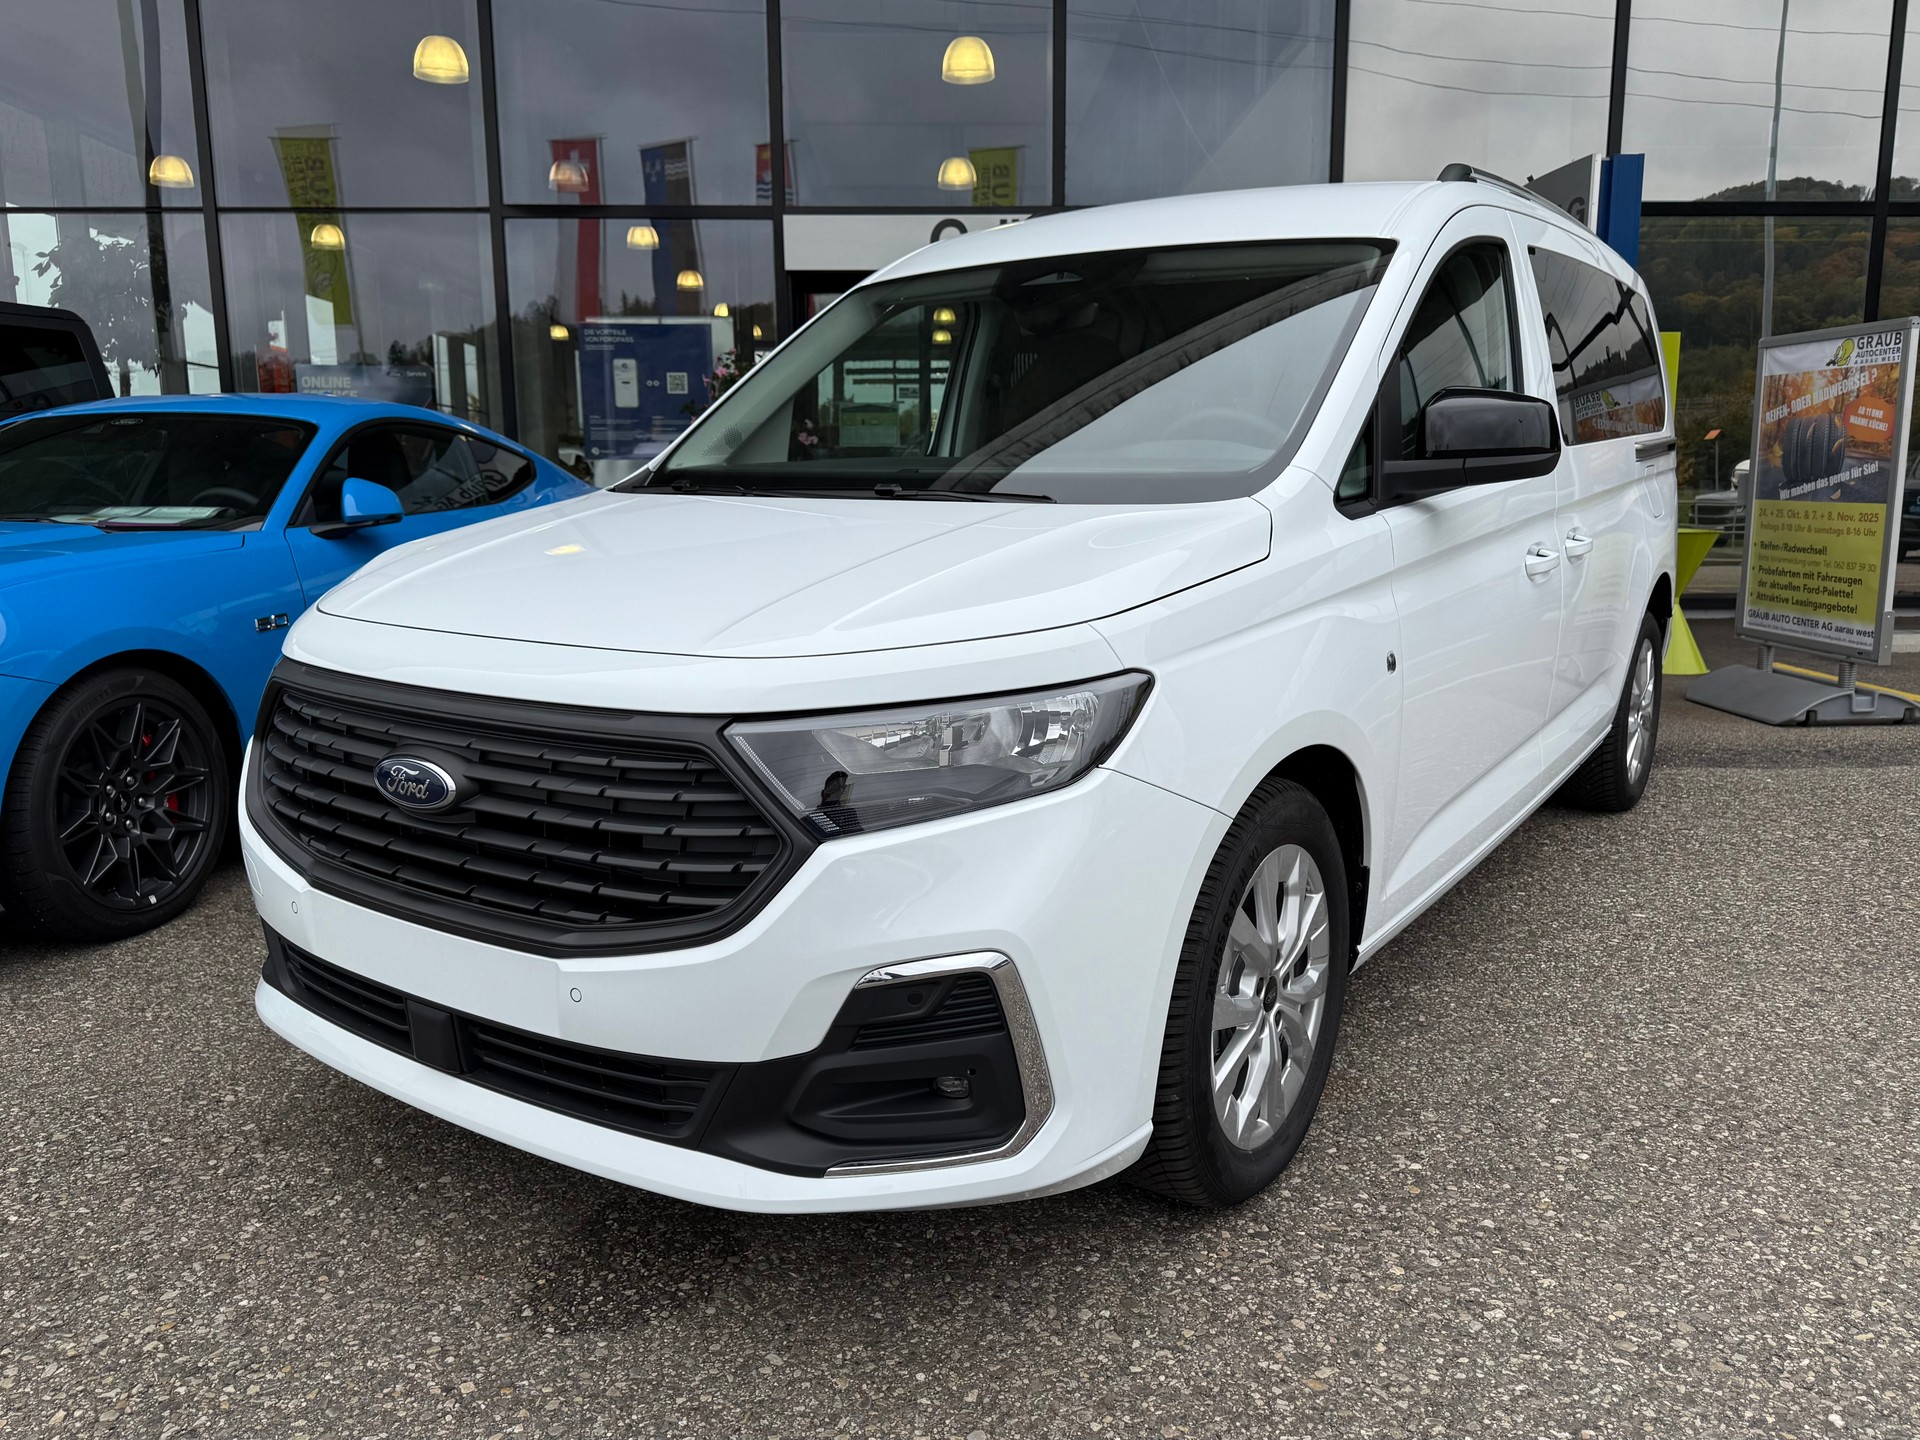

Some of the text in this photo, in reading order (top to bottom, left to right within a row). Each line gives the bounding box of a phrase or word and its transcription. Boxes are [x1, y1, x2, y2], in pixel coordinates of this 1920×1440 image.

[1854, 354, 1901, 365] AARAU WEST
[1855, 347, 1901, 359] AUTOCENTER
[301, 376, 351, 388] ONLINE
[1766, 404, 1790, 424] REIFEN-
[1791, 394, 1811, 413] ODER
[1813, 372, 1870, 404] RADWECHSEL
[1779, 460, 1879, 500] Wir machen das gerne für Sie!
[1787, 509, 1802, 519] Okt.
[1804, 510, 1809, 519] &
[1812, 510, 1818, 520] 7.
[1827, 511, 1834, 520] 8.
[1837, 511, 1855, 521] Nov.
[1858, 512, 1879, 523] 2025
[1760, 521, 1877, 537] freitags 8-18 Uhr & samstags 8-16 Uhr
[1760, 540, 1828, 556] Reifen-/Radwechsel!
[1758, 565, 1863, 586] Probefahrten mit Fahrzeugen
[1807, 559, 1821, 567] unter
[1823, 560, 1832, 568] Tel.
[1834, 560, 1844, 570] 062
[1846, 561, 1857, 571] 837
[1858, 562, 1866, 572] 59
[1867, 563, 1877, 574] 30)
[1757, 578, 1853, 599] der aktuellen Ford-Palette!
[1756, 591, 1858, 614] Attraktive Leasingangebote!
[1771, 614, 1791, 624] AUTO
[1792, 616, 1819, 630] CENTER
[1821, 622, 1833, 632] AG
[1834, 625, 1854, 635] aarau
[1856, 628, 1875, 639] west
[386, 765, 431, 800] Ford
[1204, 933, 1227, 1001] 215/55
[1222, 911, 1232, 928] R
[1229, 888, 1239, 908] 17
[1239, 867, 1249, 884] H
